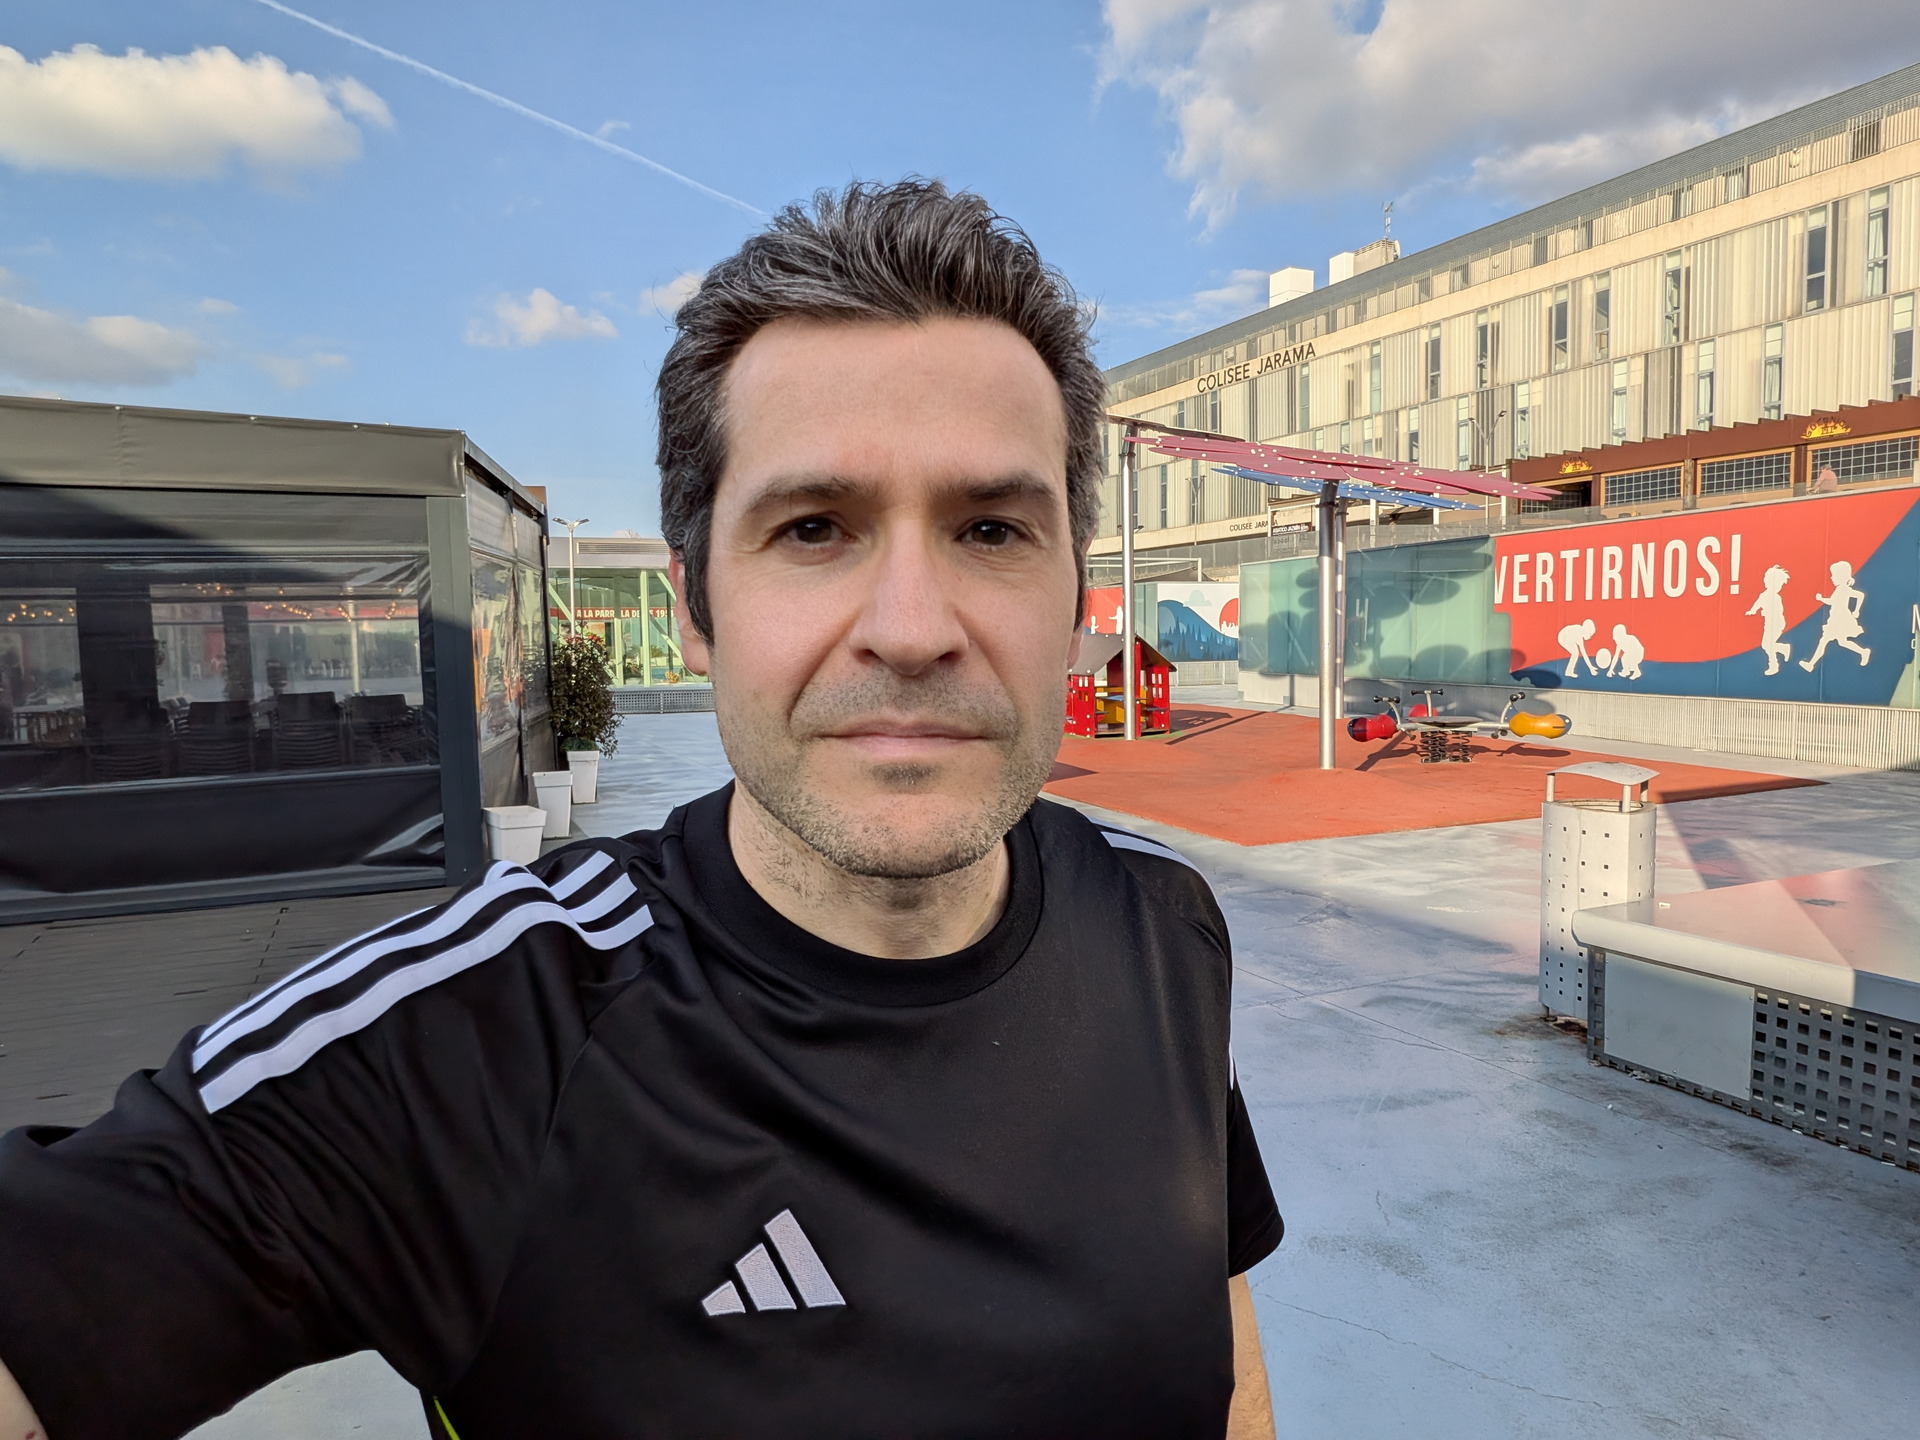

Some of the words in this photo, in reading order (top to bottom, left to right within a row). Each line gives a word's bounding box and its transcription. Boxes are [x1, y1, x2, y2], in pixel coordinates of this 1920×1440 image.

[1197, 362, 1251, 393] COLISEE
[1257, 342, 1316, 375] JARAMA
[1229, 522, 1253, 532] COLISEE
[1254, 519, 1279, 529] JARAA
[1494, 534, 1742, 604] VERTIRNOS!
[583, 609, 593, 618] LA
[595, 609, 631, 618] PARRLA
